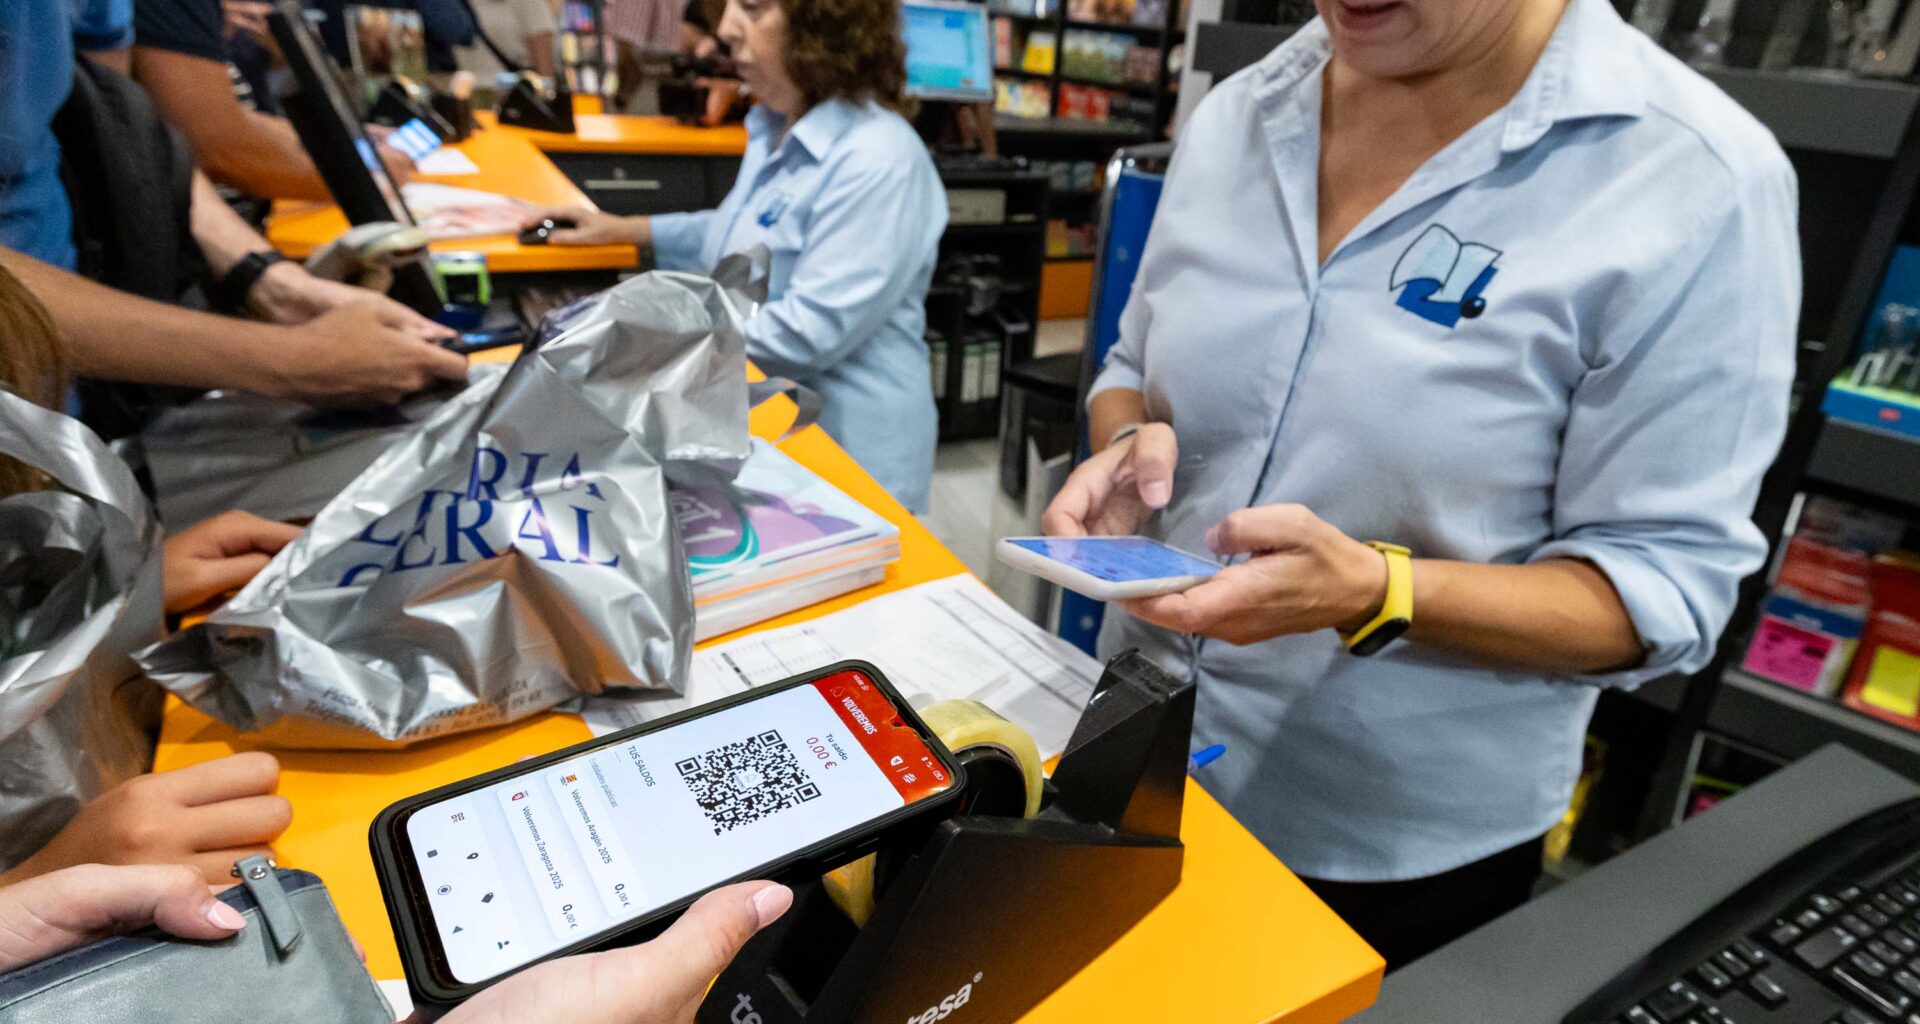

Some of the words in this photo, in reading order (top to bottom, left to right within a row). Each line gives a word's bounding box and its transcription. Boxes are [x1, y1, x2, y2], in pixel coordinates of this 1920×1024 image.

[842, 696, 878, 735] VOLVEREMOS
[628, 745, 641, 760] TUS
[806, 737, 830, 760] 0,00
[824, 760, 838, 770] €
[825, 733, 834, 744] Tu
[831, 742, 848, 761] saldo
[634, 759, 656, 787] SALDOS
[571, 789, 591, 824] Volveremos
[588, 824, 602, 847] Aragón
[598, 847, 613, 864] 2025
[522, 805, 541, 842] Volveremos
[536, 841, 554, 872] Zaragoza
[549, 871, 564, 890] 2025
